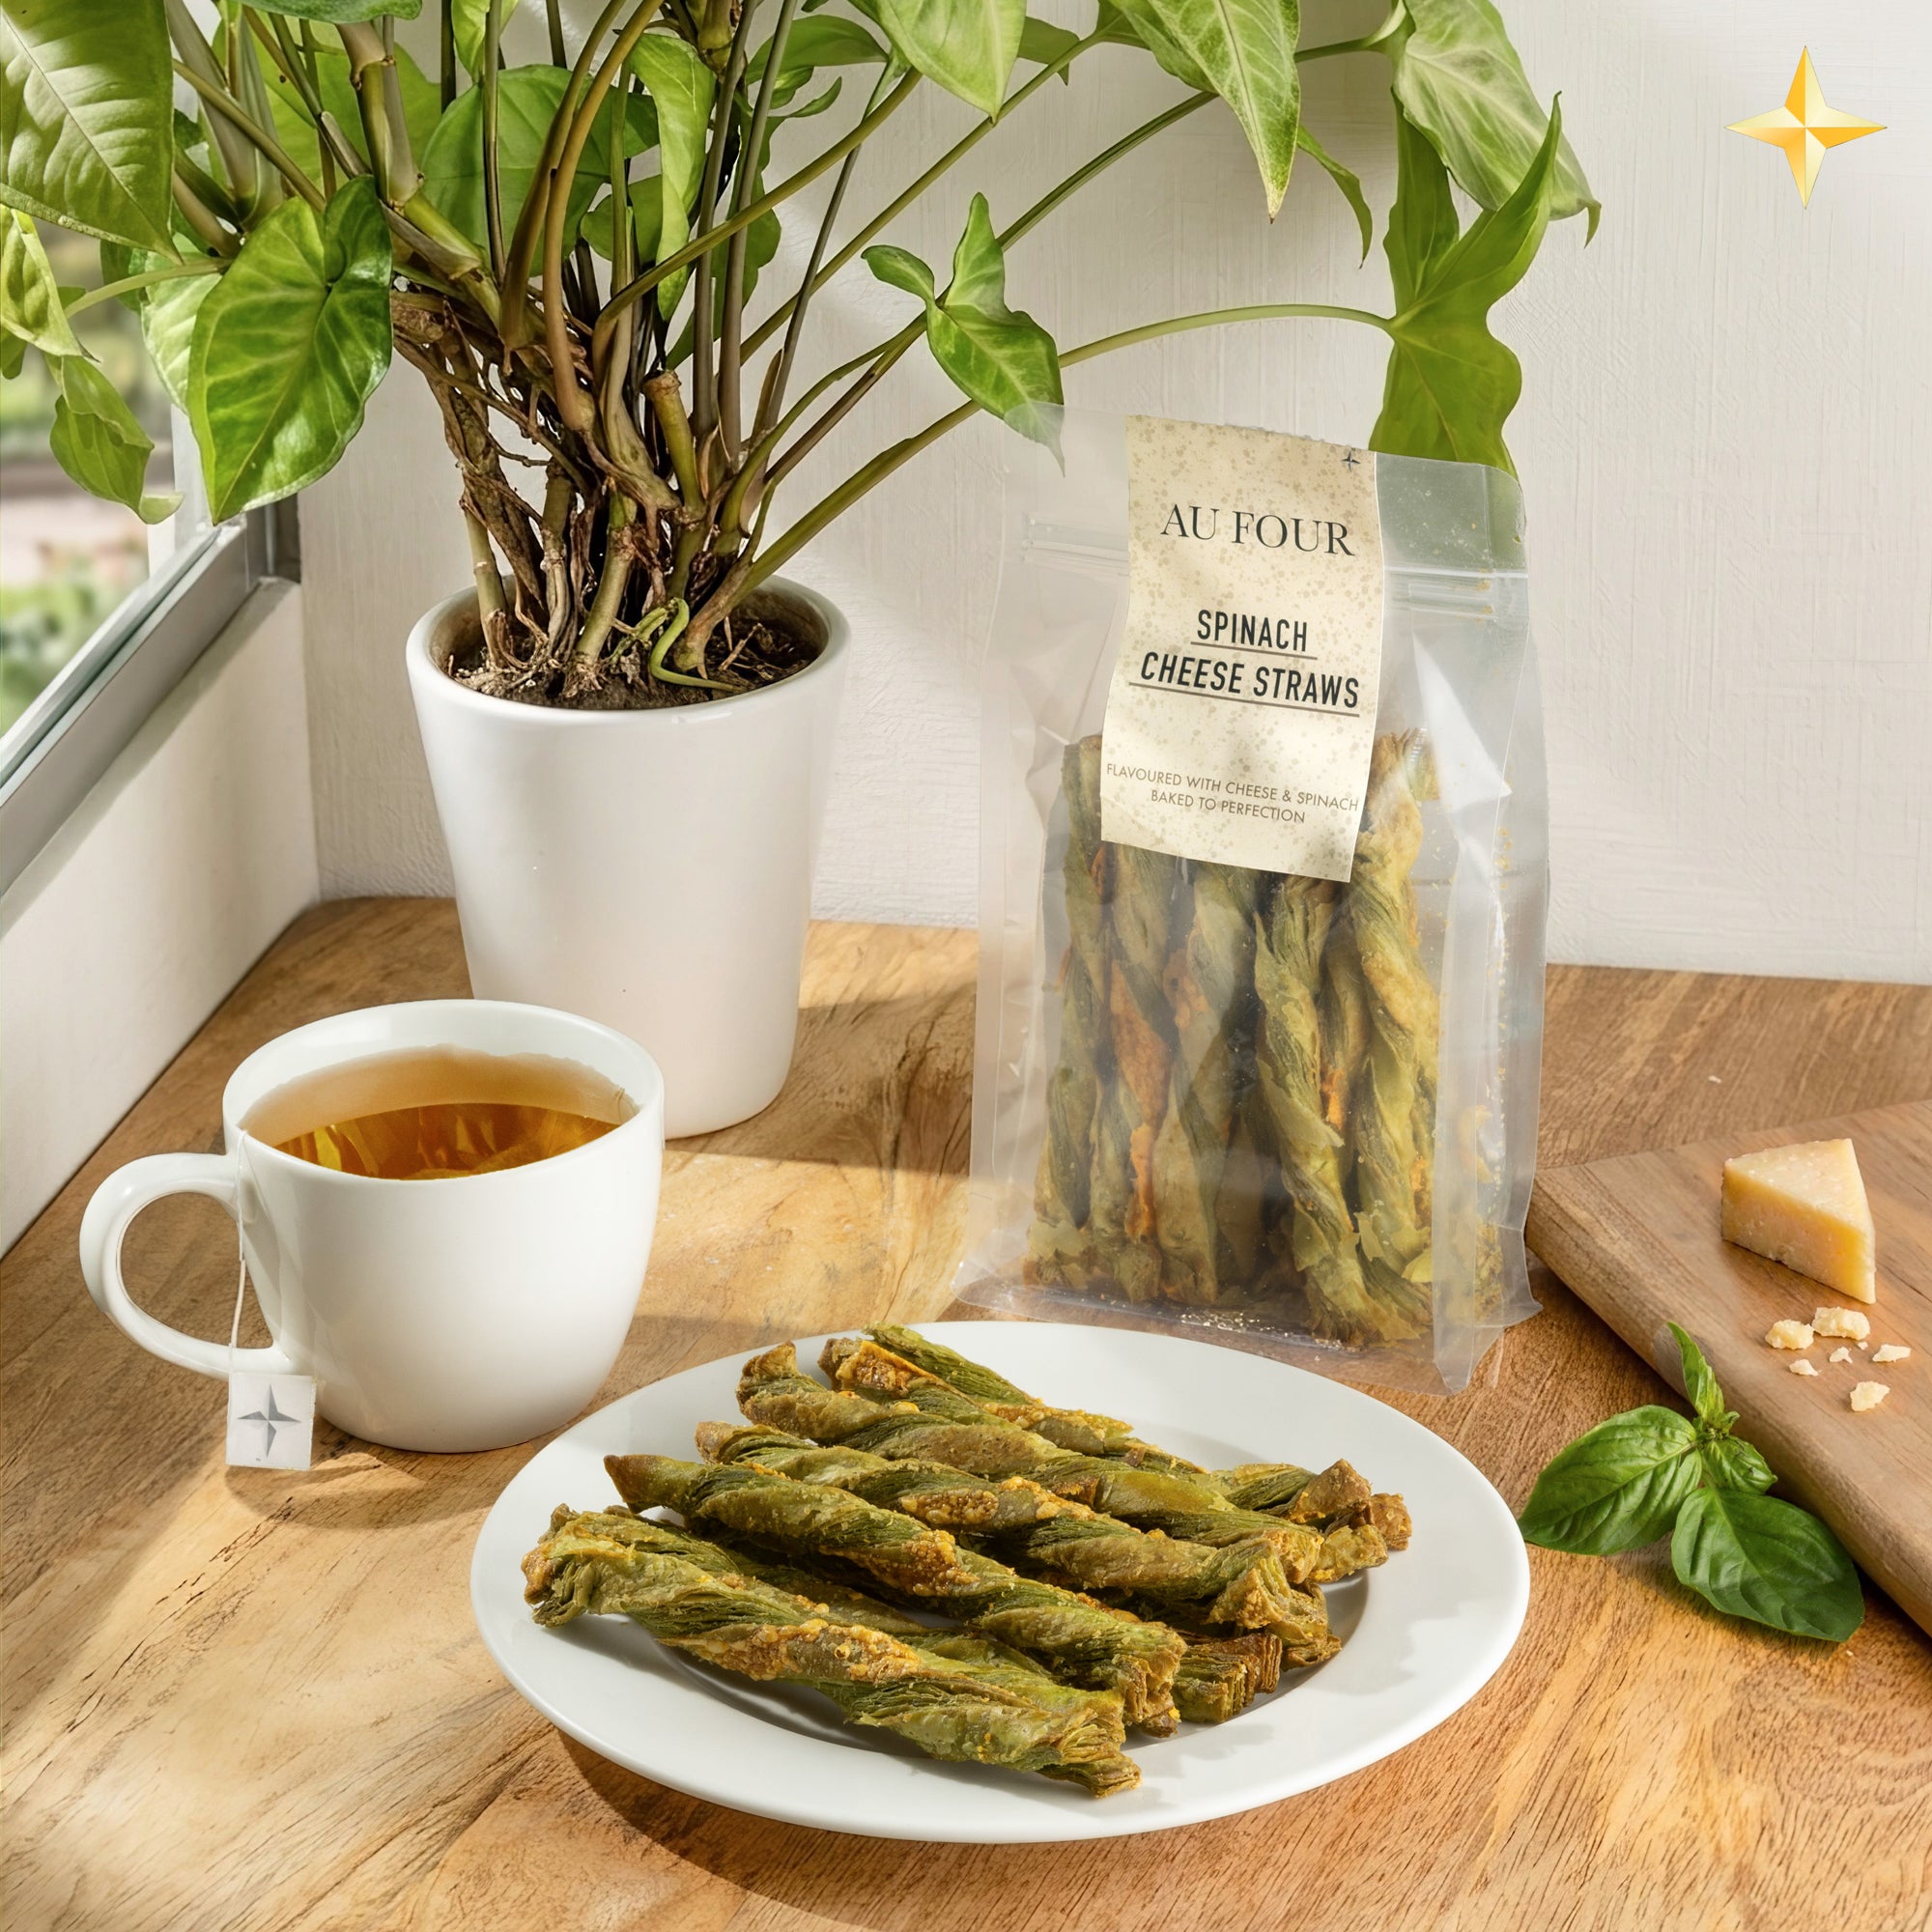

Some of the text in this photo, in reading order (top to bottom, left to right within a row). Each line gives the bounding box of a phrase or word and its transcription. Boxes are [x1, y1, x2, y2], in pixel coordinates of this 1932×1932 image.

[1160, 504, 1355, 556] AU FOUR
[1197, 609, 1309, 653] SPINACH
[1141, 651, 1359, 709] CHEESE STRAWS
[1106, 762, 1359, 812] FLAVOURED WITH CHEESE & SPINACH
[1151, 789, 1306, 824] BAKED TO PERFECTION
